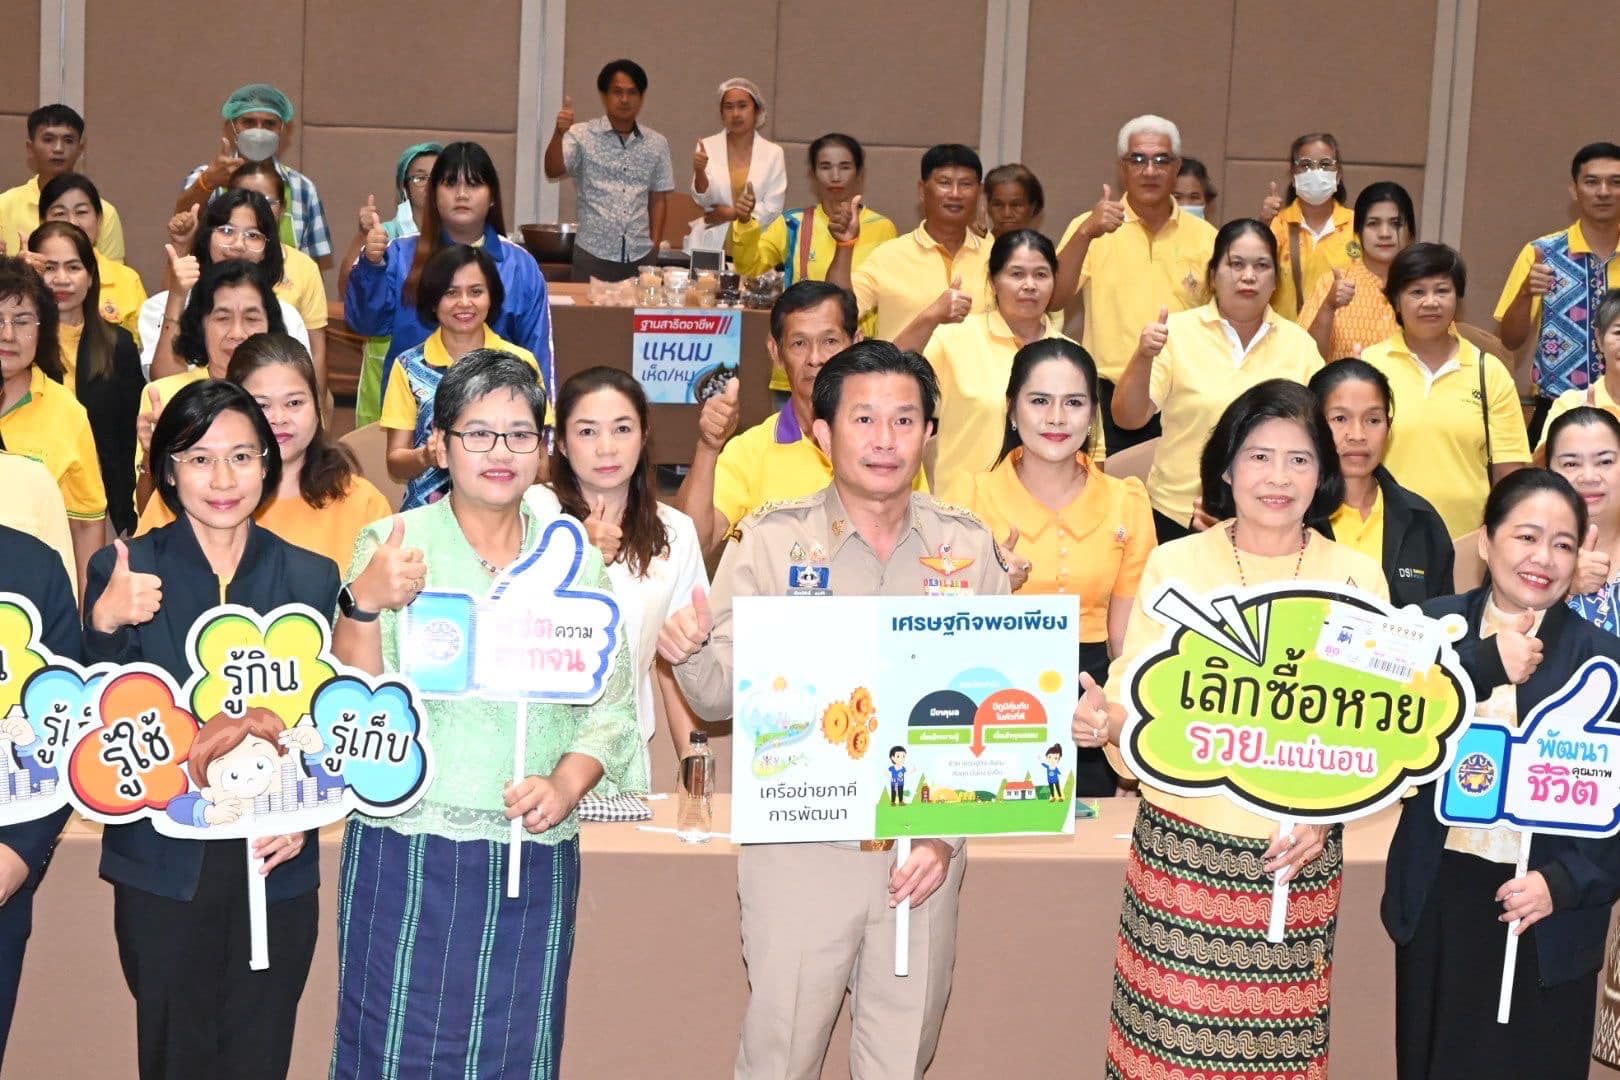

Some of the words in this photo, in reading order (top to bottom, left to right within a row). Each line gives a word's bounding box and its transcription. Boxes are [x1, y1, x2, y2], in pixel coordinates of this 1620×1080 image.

[640, 318, 715, 331] ฐานสาธิตอาชีพ
[643, 341, 713, 362] แหนม
[554, 624, 593, 640] ความ
[892, 609, 1068, 636] เศรษฐกิจพอเพียง
[223, 649, 299, 715] รู้กิน
[1180, 647, 1426, 734] เลิกซื้อหวย
[103, 711, 170, 797] รู้ใช้
[324, 712, 410, 773] รู้เก็บ
[1537, 729, 1609, 763] พัฒนา
[1527, 762, 1600, 806] ชีวิต
[1572, 766, 1613, 779] คุณภาพ
[760, 780, 857, 799] เครือข่ายภาคี
[768, 804, 848, 822] การพัฒนา
